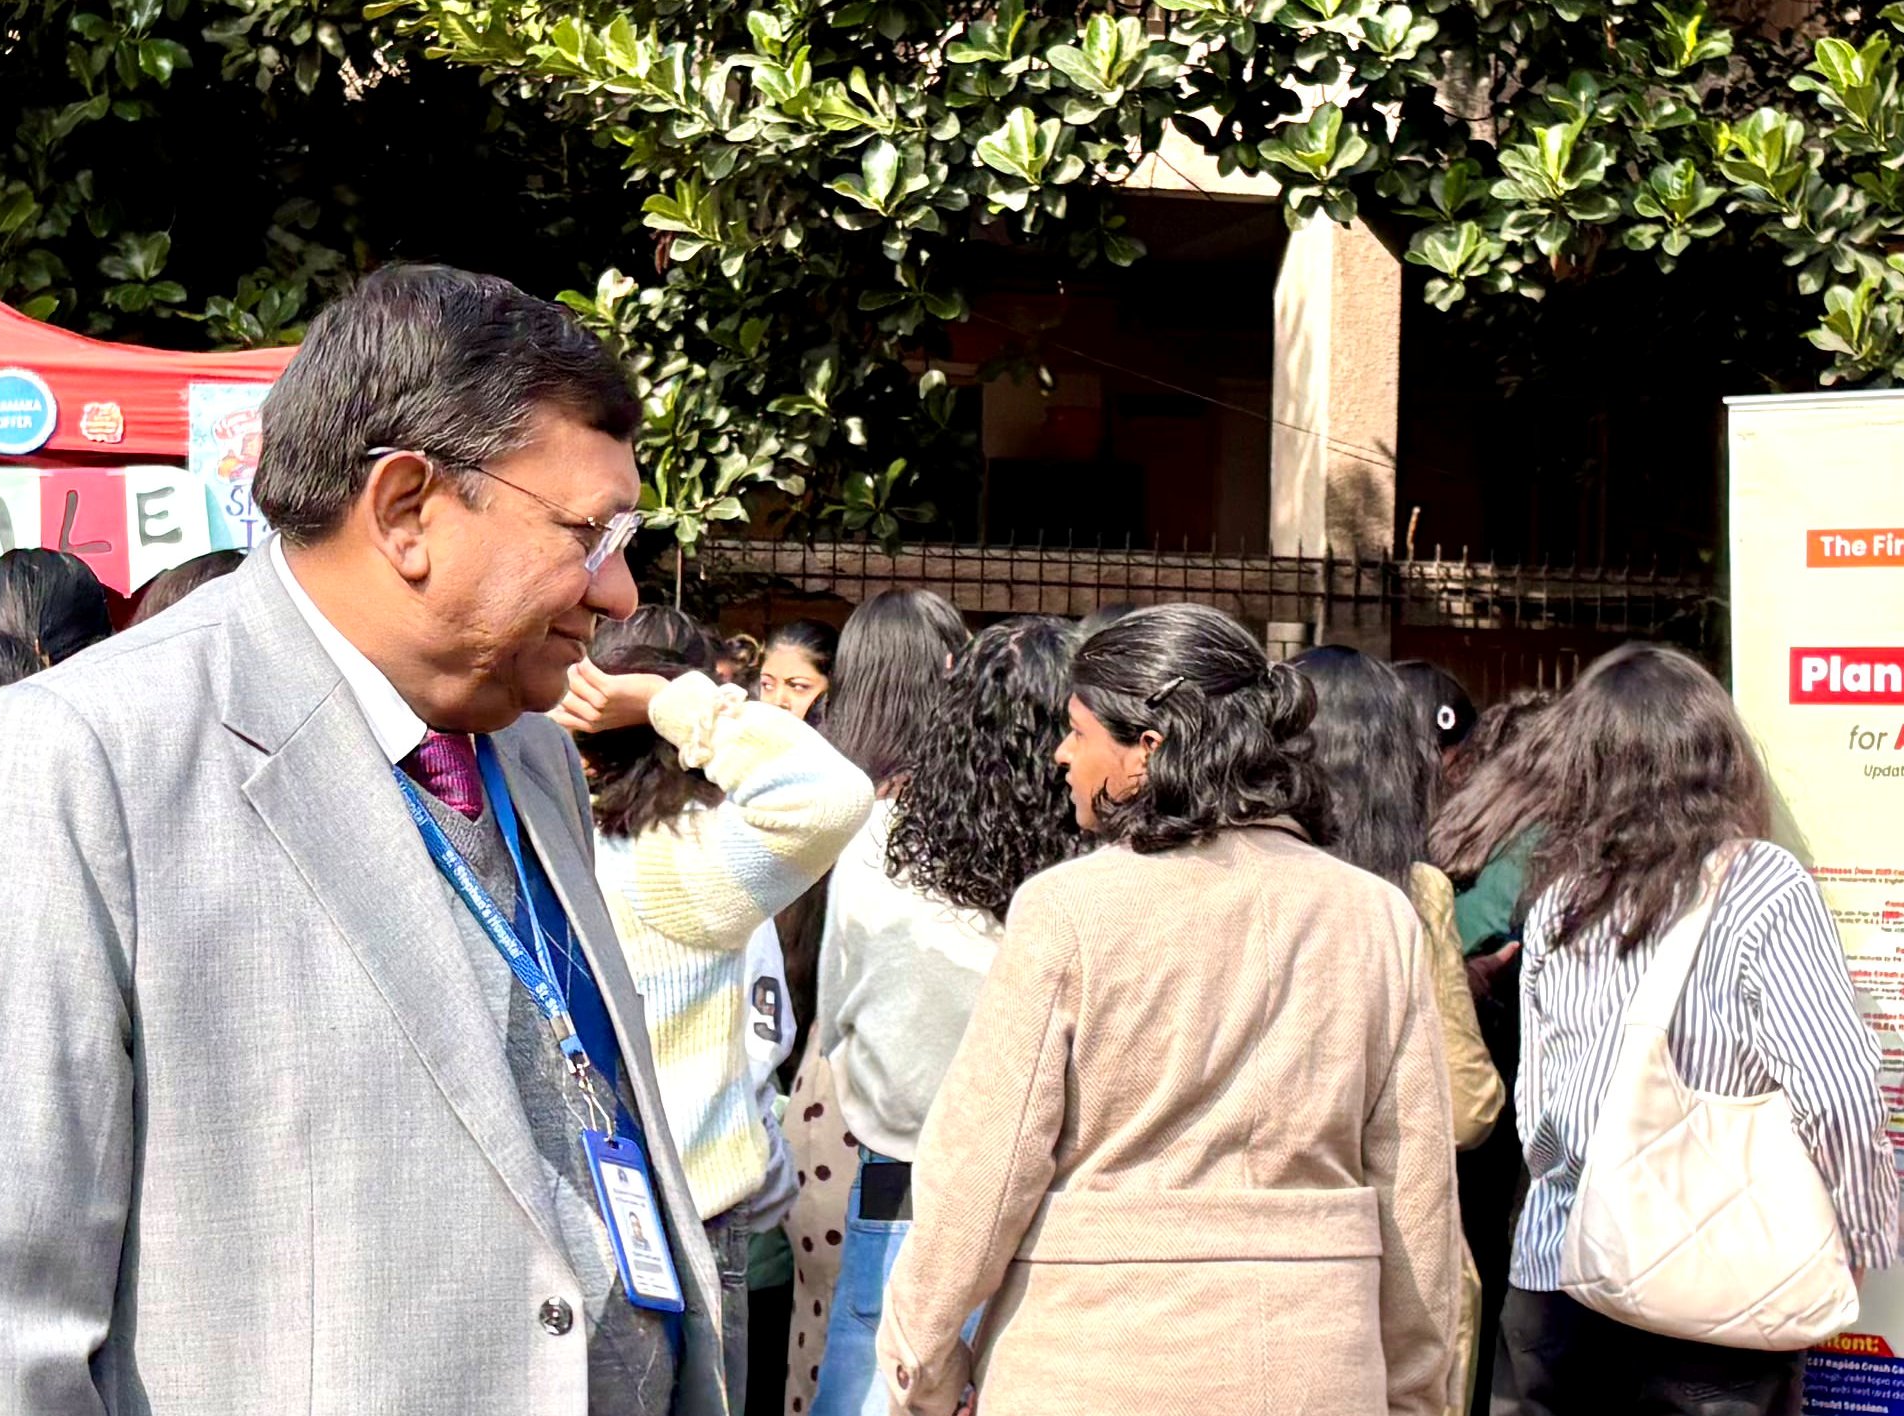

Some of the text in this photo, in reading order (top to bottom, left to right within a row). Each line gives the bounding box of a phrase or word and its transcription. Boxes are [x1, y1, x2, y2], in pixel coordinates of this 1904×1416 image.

[1820, 536, 1867, 557] The
[1801, 655, 1902, 693] Plan
[1848, 725, 1888, 750] for
